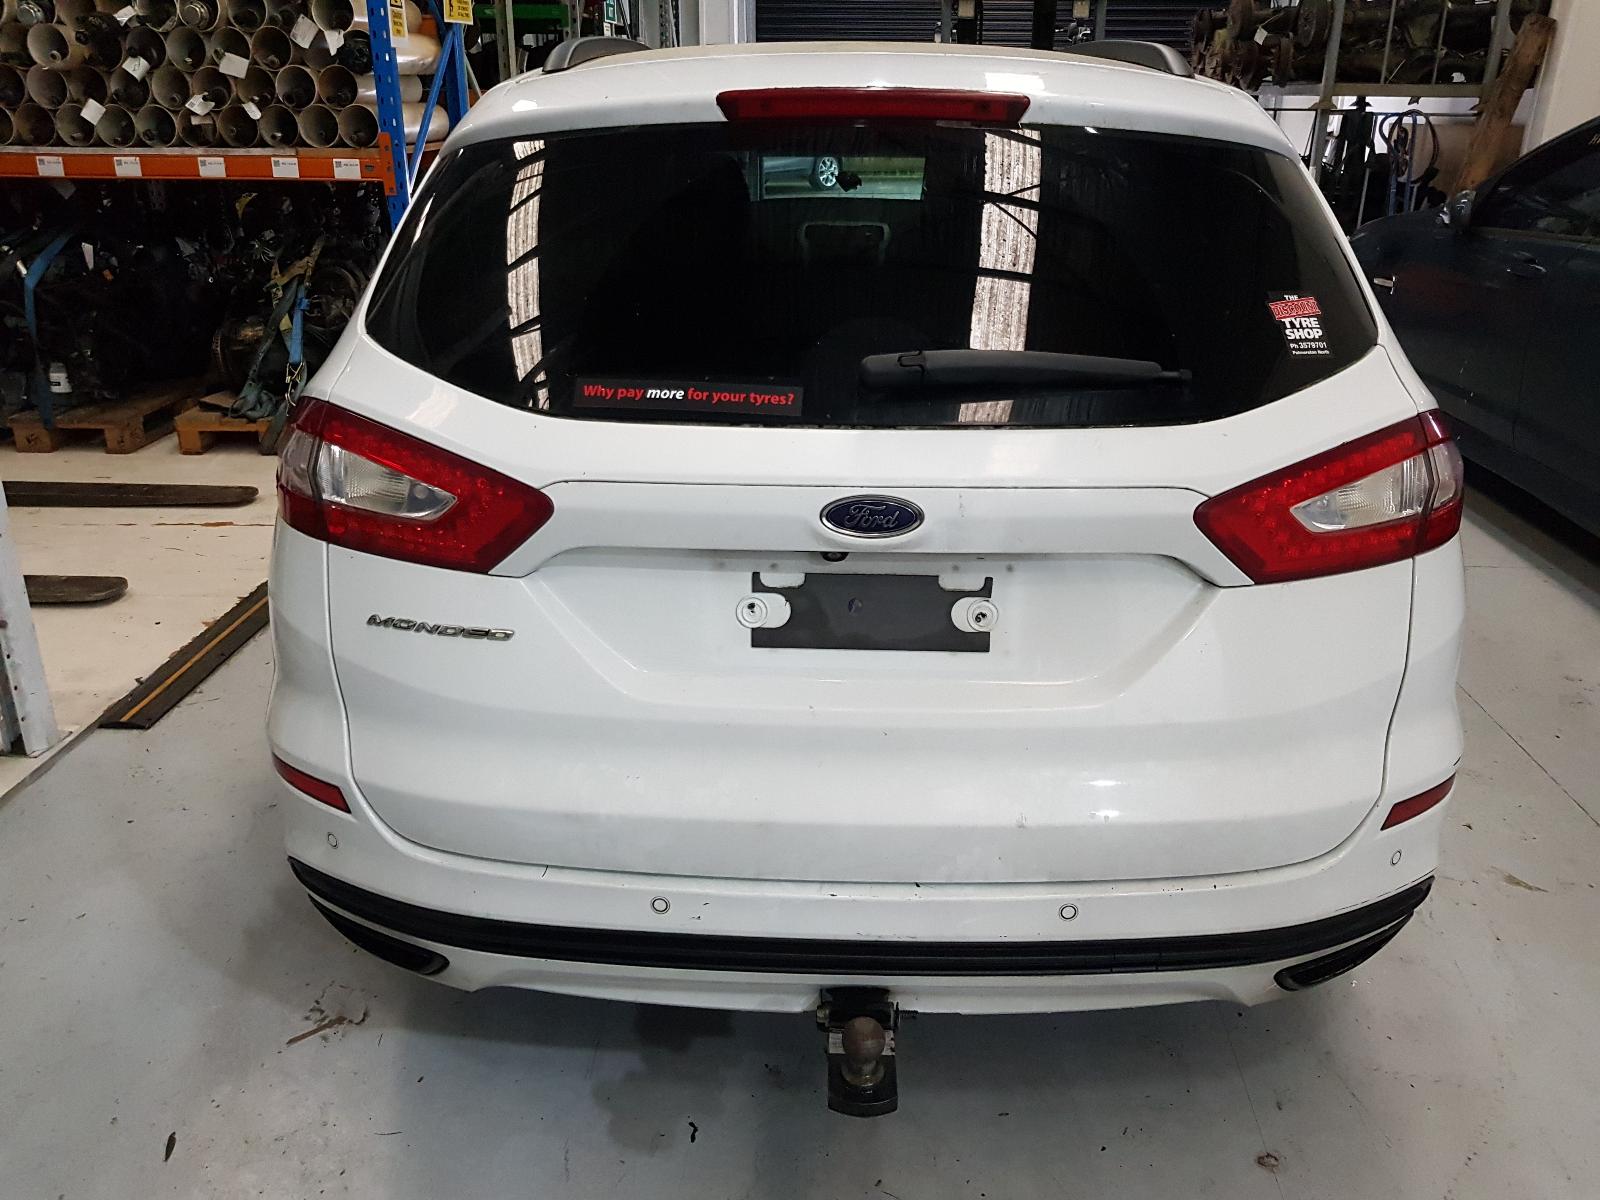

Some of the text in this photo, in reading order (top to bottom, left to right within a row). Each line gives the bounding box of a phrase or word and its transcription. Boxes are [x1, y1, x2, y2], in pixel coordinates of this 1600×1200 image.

[1281, 317, 1320, 329] TYRE
[1285, 328, 1323, 340] SHOP
[583, 384, 795, 406] Why pay more for your tyres?
[843, 503, 900, 528] Ford
[366, 613, 514, 642] MONDEO
